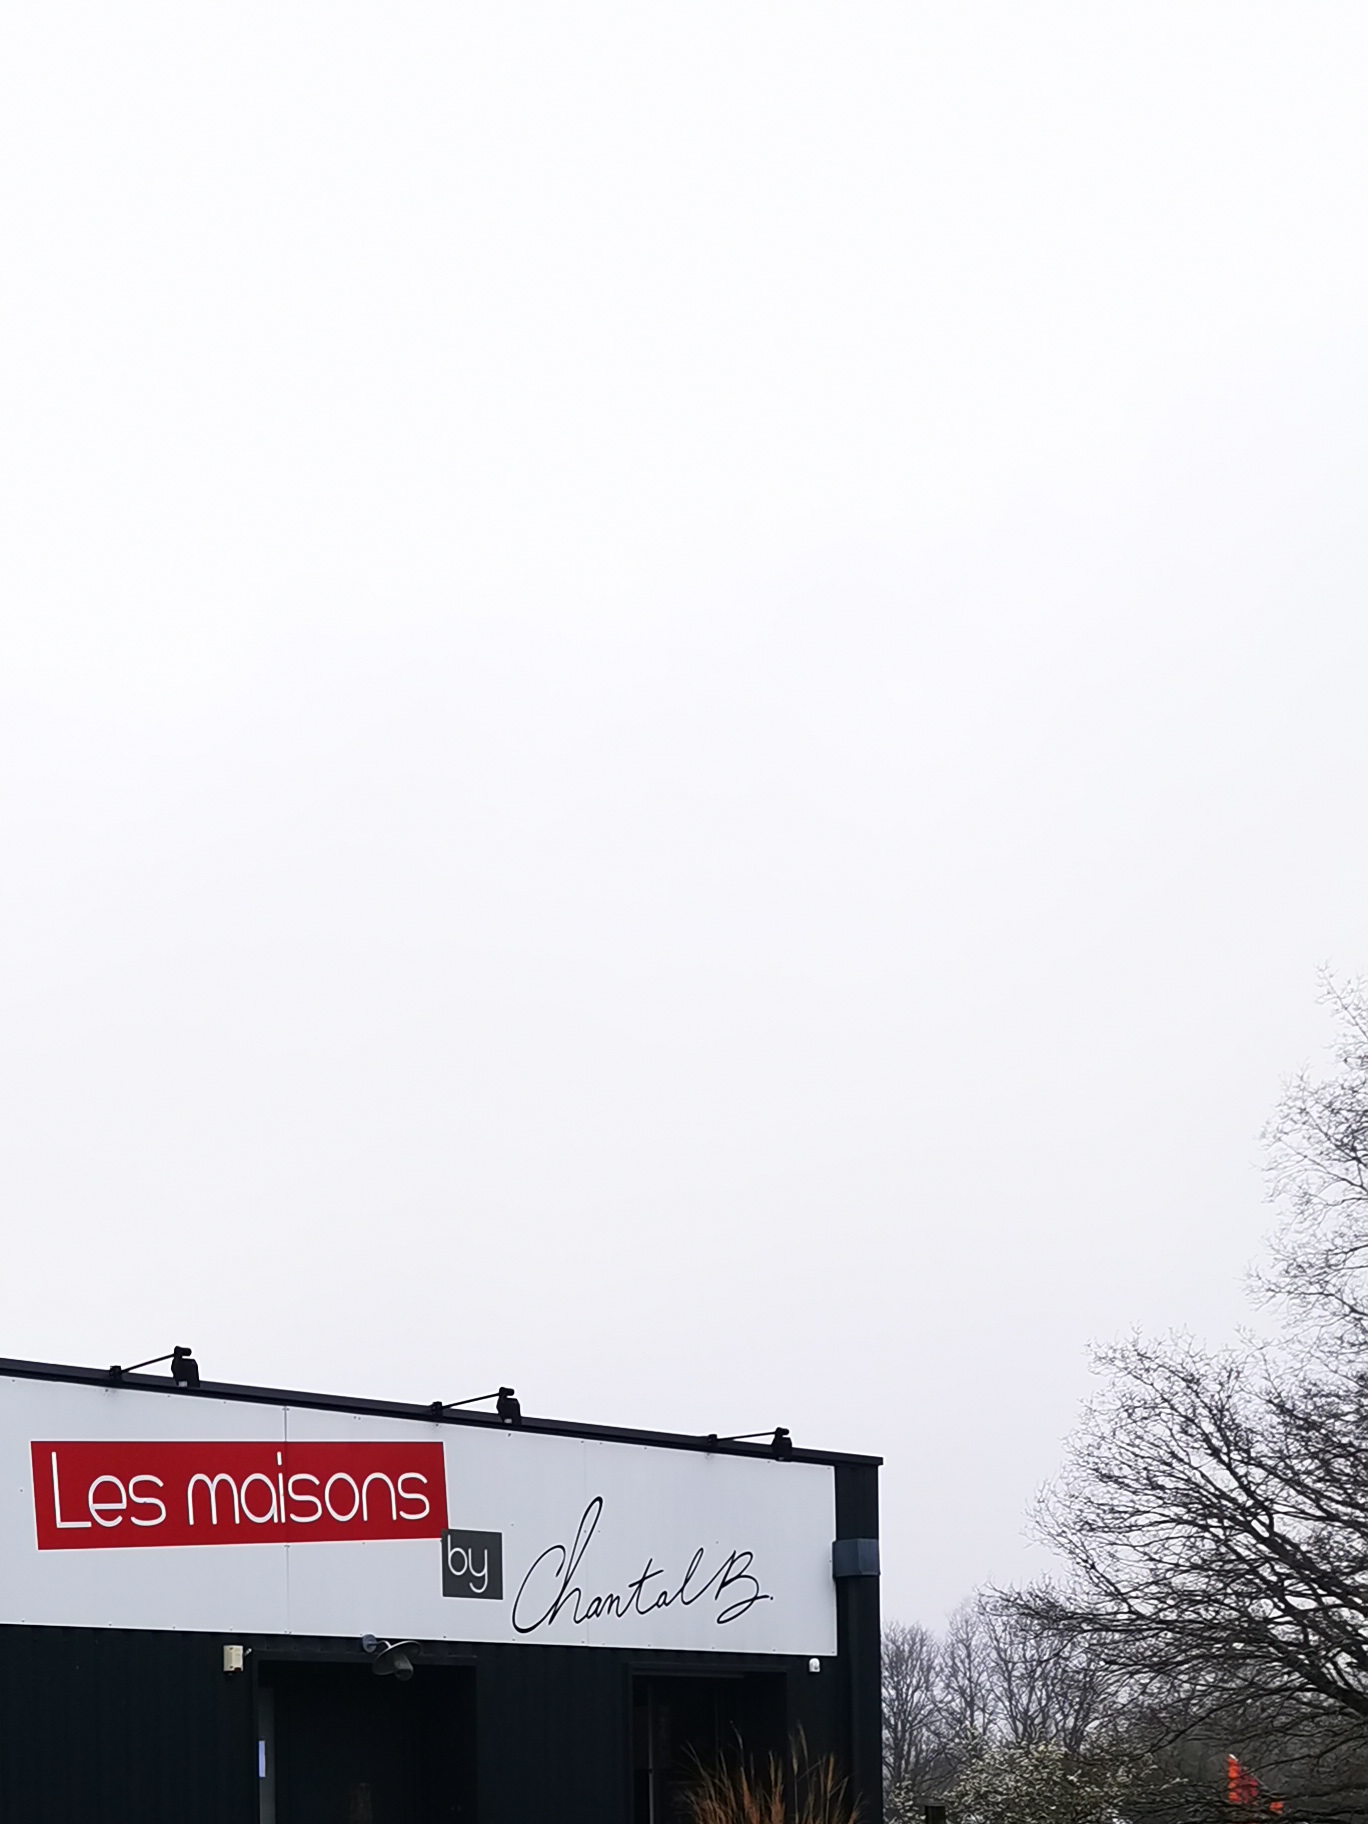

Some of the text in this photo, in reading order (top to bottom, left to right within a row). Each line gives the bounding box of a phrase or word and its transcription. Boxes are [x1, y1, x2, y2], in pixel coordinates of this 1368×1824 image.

[50, 1451, 430, 1528] Les maisons
[447, 1534, 488, 1592] by
[512, 1496, 705, 1633] Chantal
